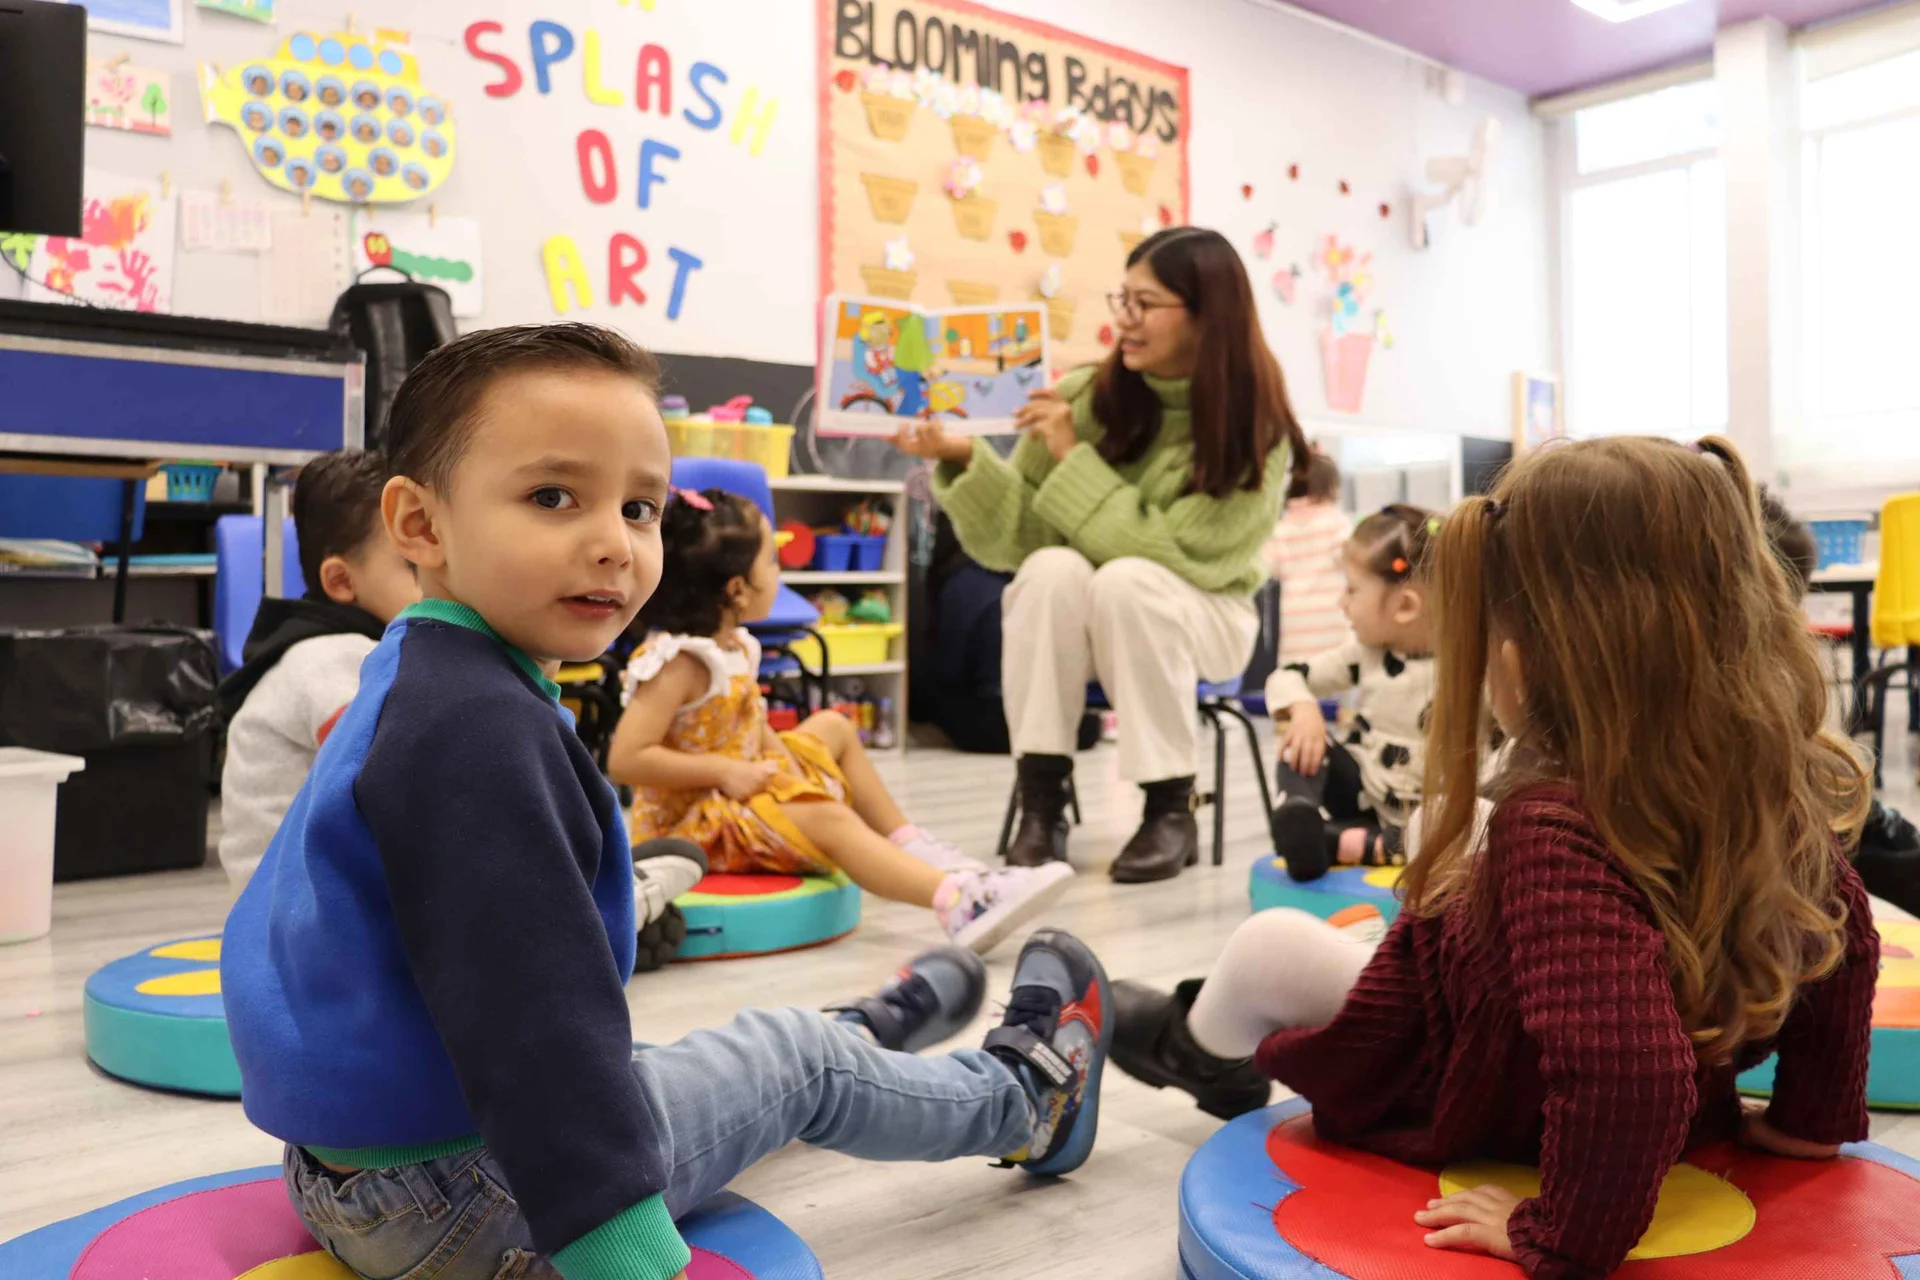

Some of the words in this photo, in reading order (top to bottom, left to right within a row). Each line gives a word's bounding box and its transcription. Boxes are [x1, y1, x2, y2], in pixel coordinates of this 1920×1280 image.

[464, 20, 778, 156] SPLASH
[1063, 55, 1179, 143] Bdays
[576, 129, 681, 209] OF
[542, 232, 704, 320] ART
